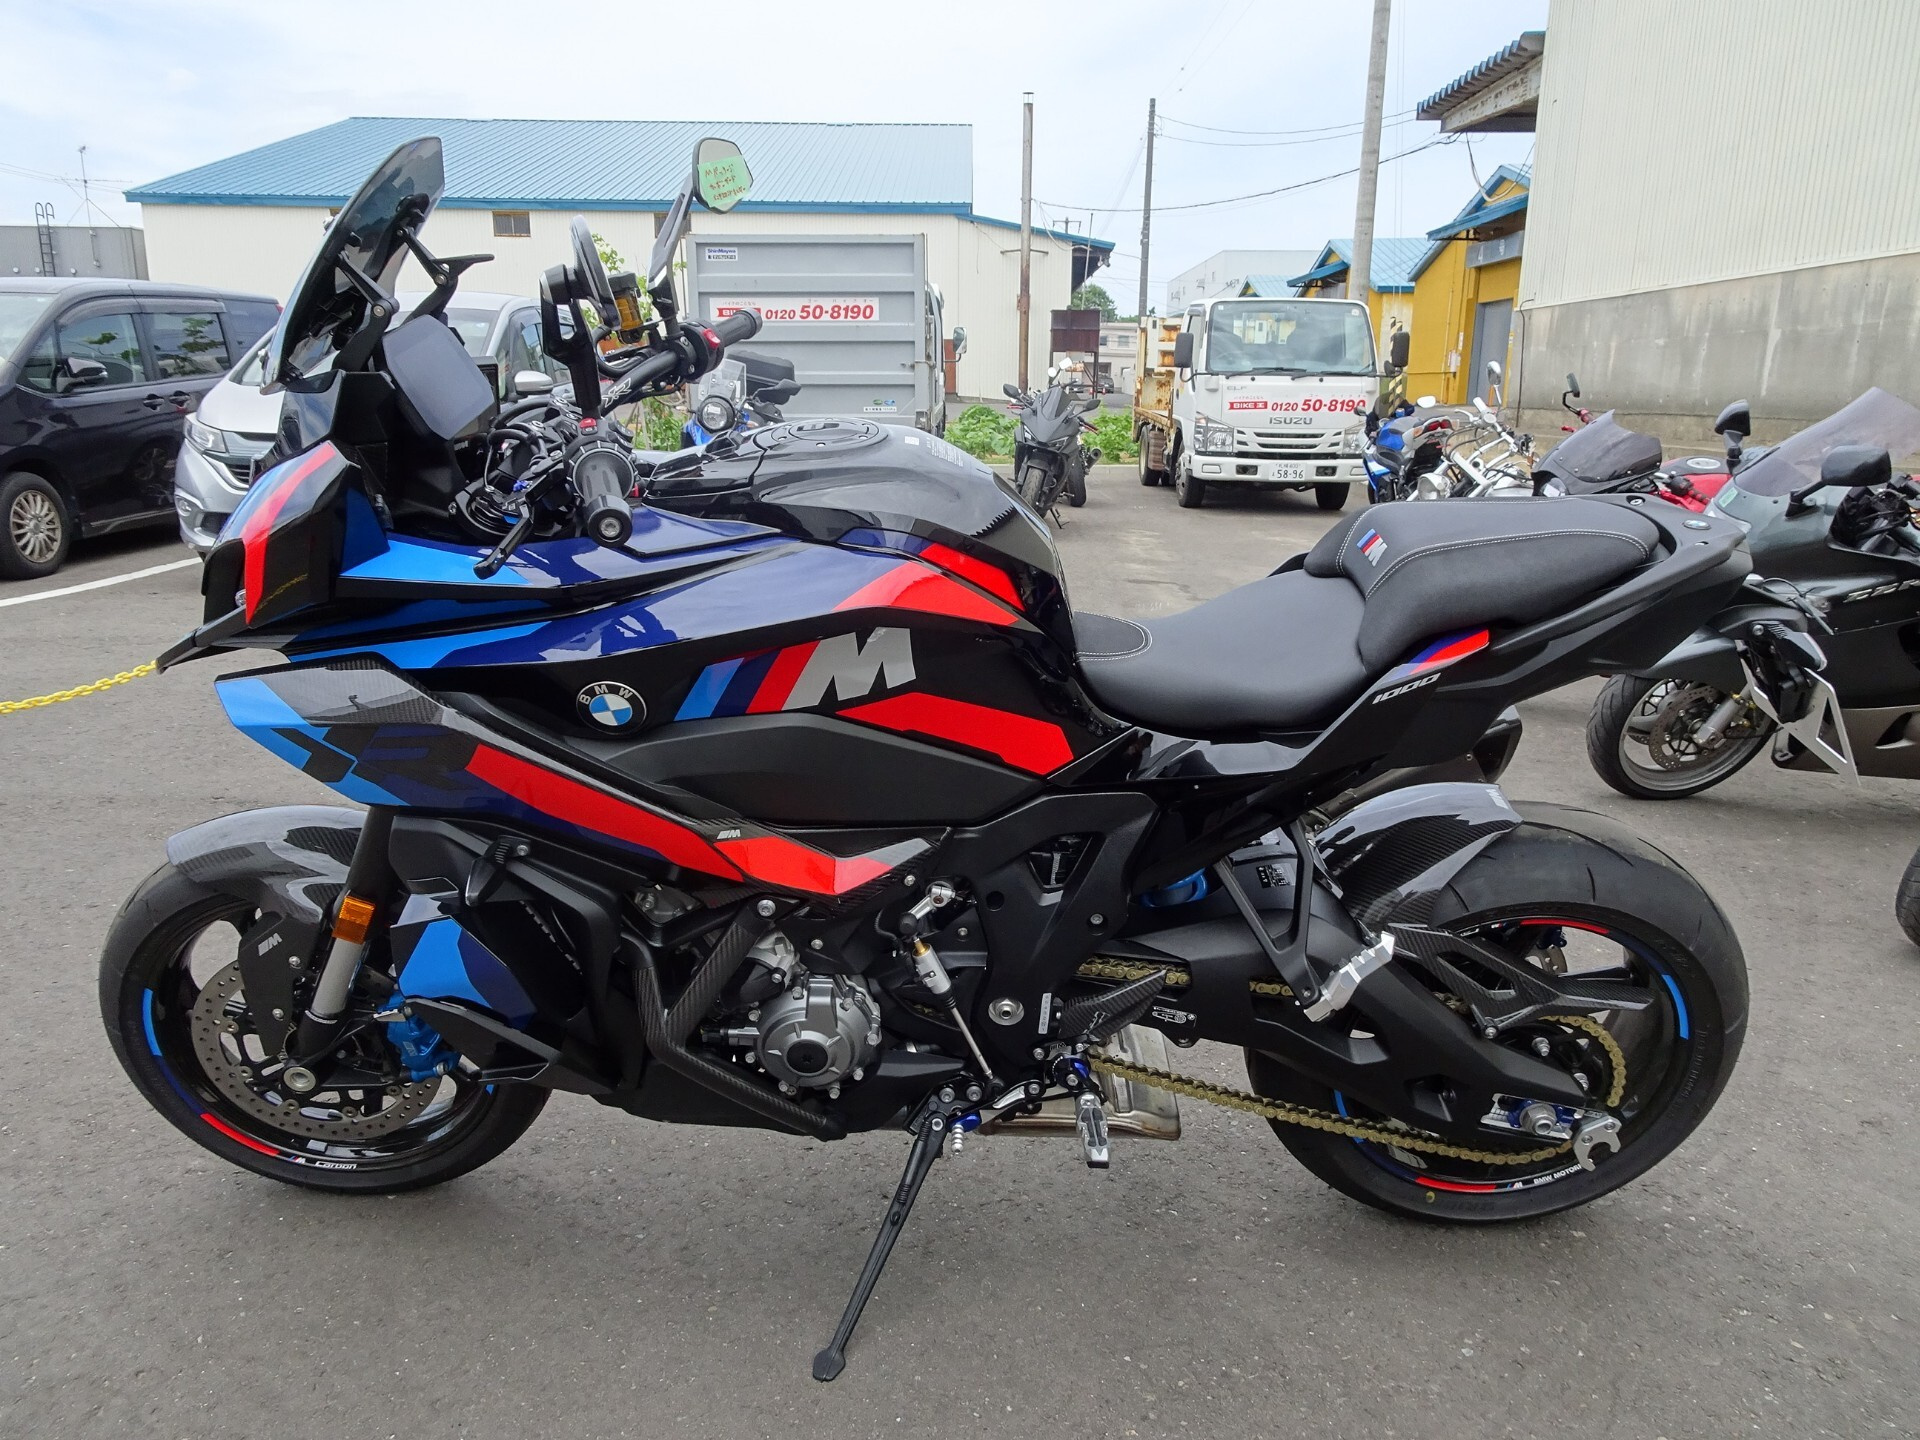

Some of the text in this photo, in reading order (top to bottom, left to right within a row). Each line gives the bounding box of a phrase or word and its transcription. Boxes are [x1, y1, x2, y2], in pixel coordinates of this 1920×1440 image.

[765, 304, 874, 320] 0120 50-8190
[1271, 402, 1299, 412] 0120
[1269, 417, 1313, 425] ISUZU
[1277, 469, 1304, 479] 58-96
[781, 626, 917, 711] M
[1372, 672, 1442, 705] 1000
[579, 684, 633, 705] BMW
[314, 1160, 358, 1170] Carbon
[1533, 1175, 1553, 1185] BMW
